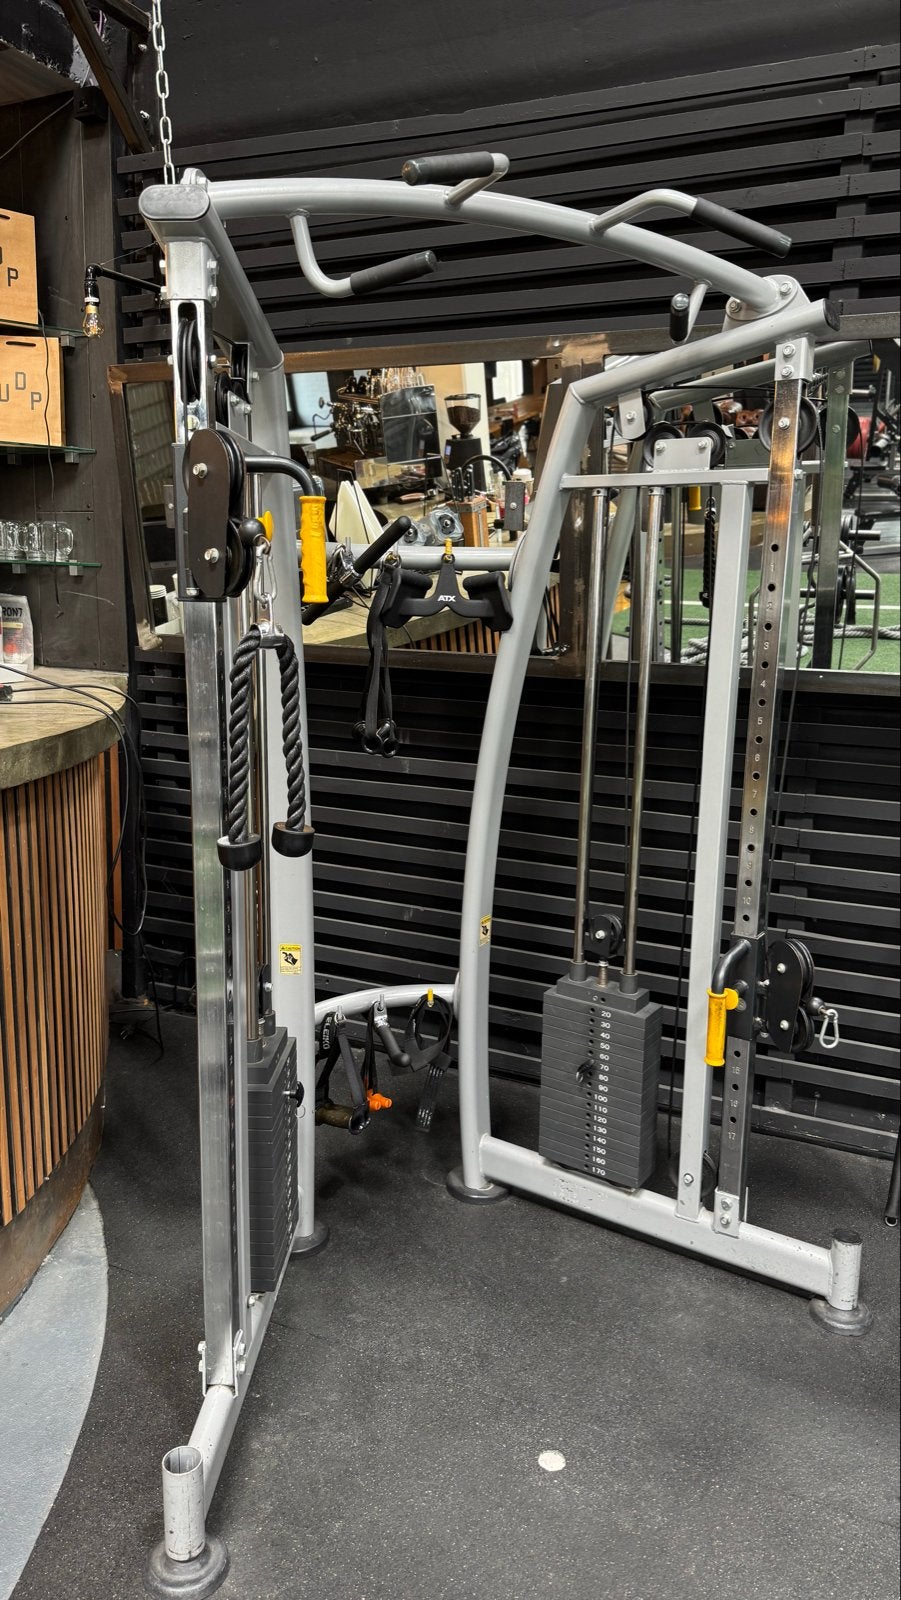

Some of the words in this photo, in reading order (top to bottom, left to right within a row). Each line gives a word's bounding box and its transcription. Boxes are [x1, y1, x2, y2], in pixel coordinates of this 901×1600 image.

[7, 267, 19, 287] P
[760, 680, 767, 688] 4
[757, 716, 763, 725] 5
[754, 754, 760, 762] 6
[752, 790, 758, 799] 7
[742, 896, 751, 905] 10
[601, 1010, 612, 1019] 20
[600, 1021, 611, 1029] 30
[600, 1032, 611, 1040] 40
[600, 1042, 610, 1050] 50
[599, 1053, 610, 1061] 60
[599, 1064, 609, 1072] 70
[598, 1074, 609, 1082] 80
[598, 1085, 608, 1093] 90
[594, 1094, 608, 1103] 100
[593, 1104, 608, 1114] 110
[593, 1115, 607, 1124] 120
[593, 1125, 607, 1135] 130
[592, 1135, 607, 1145] 140
[592, 1146, 606, 1155] 150
[592, 1156, 606, 1165] 160
[591, 1166, 606, 1176] 170
